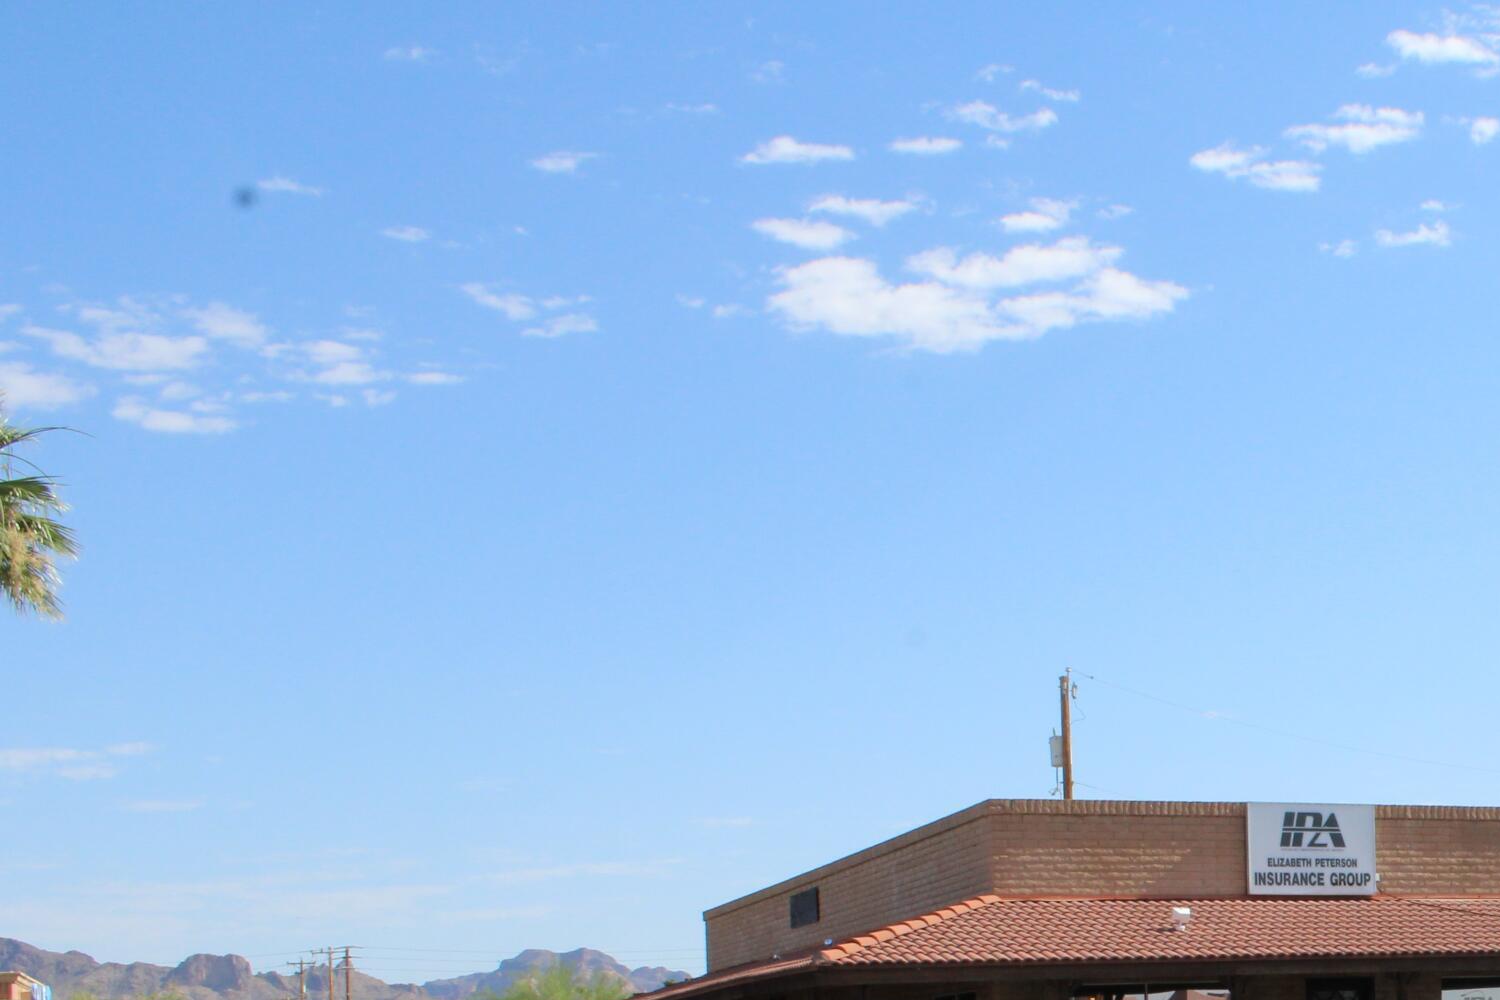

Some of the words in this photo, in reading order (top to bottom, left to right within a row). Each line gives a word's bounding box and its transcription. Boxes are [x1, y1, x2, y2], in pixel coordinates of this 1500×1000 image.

[1267, 858, 1312, 867] ELIZABETH
[1315, 858, 1357, 867] PETERSON
[1254, 872, 1325, 886] INSURANCE
[1330, 873, 1371, 886] GROUP
